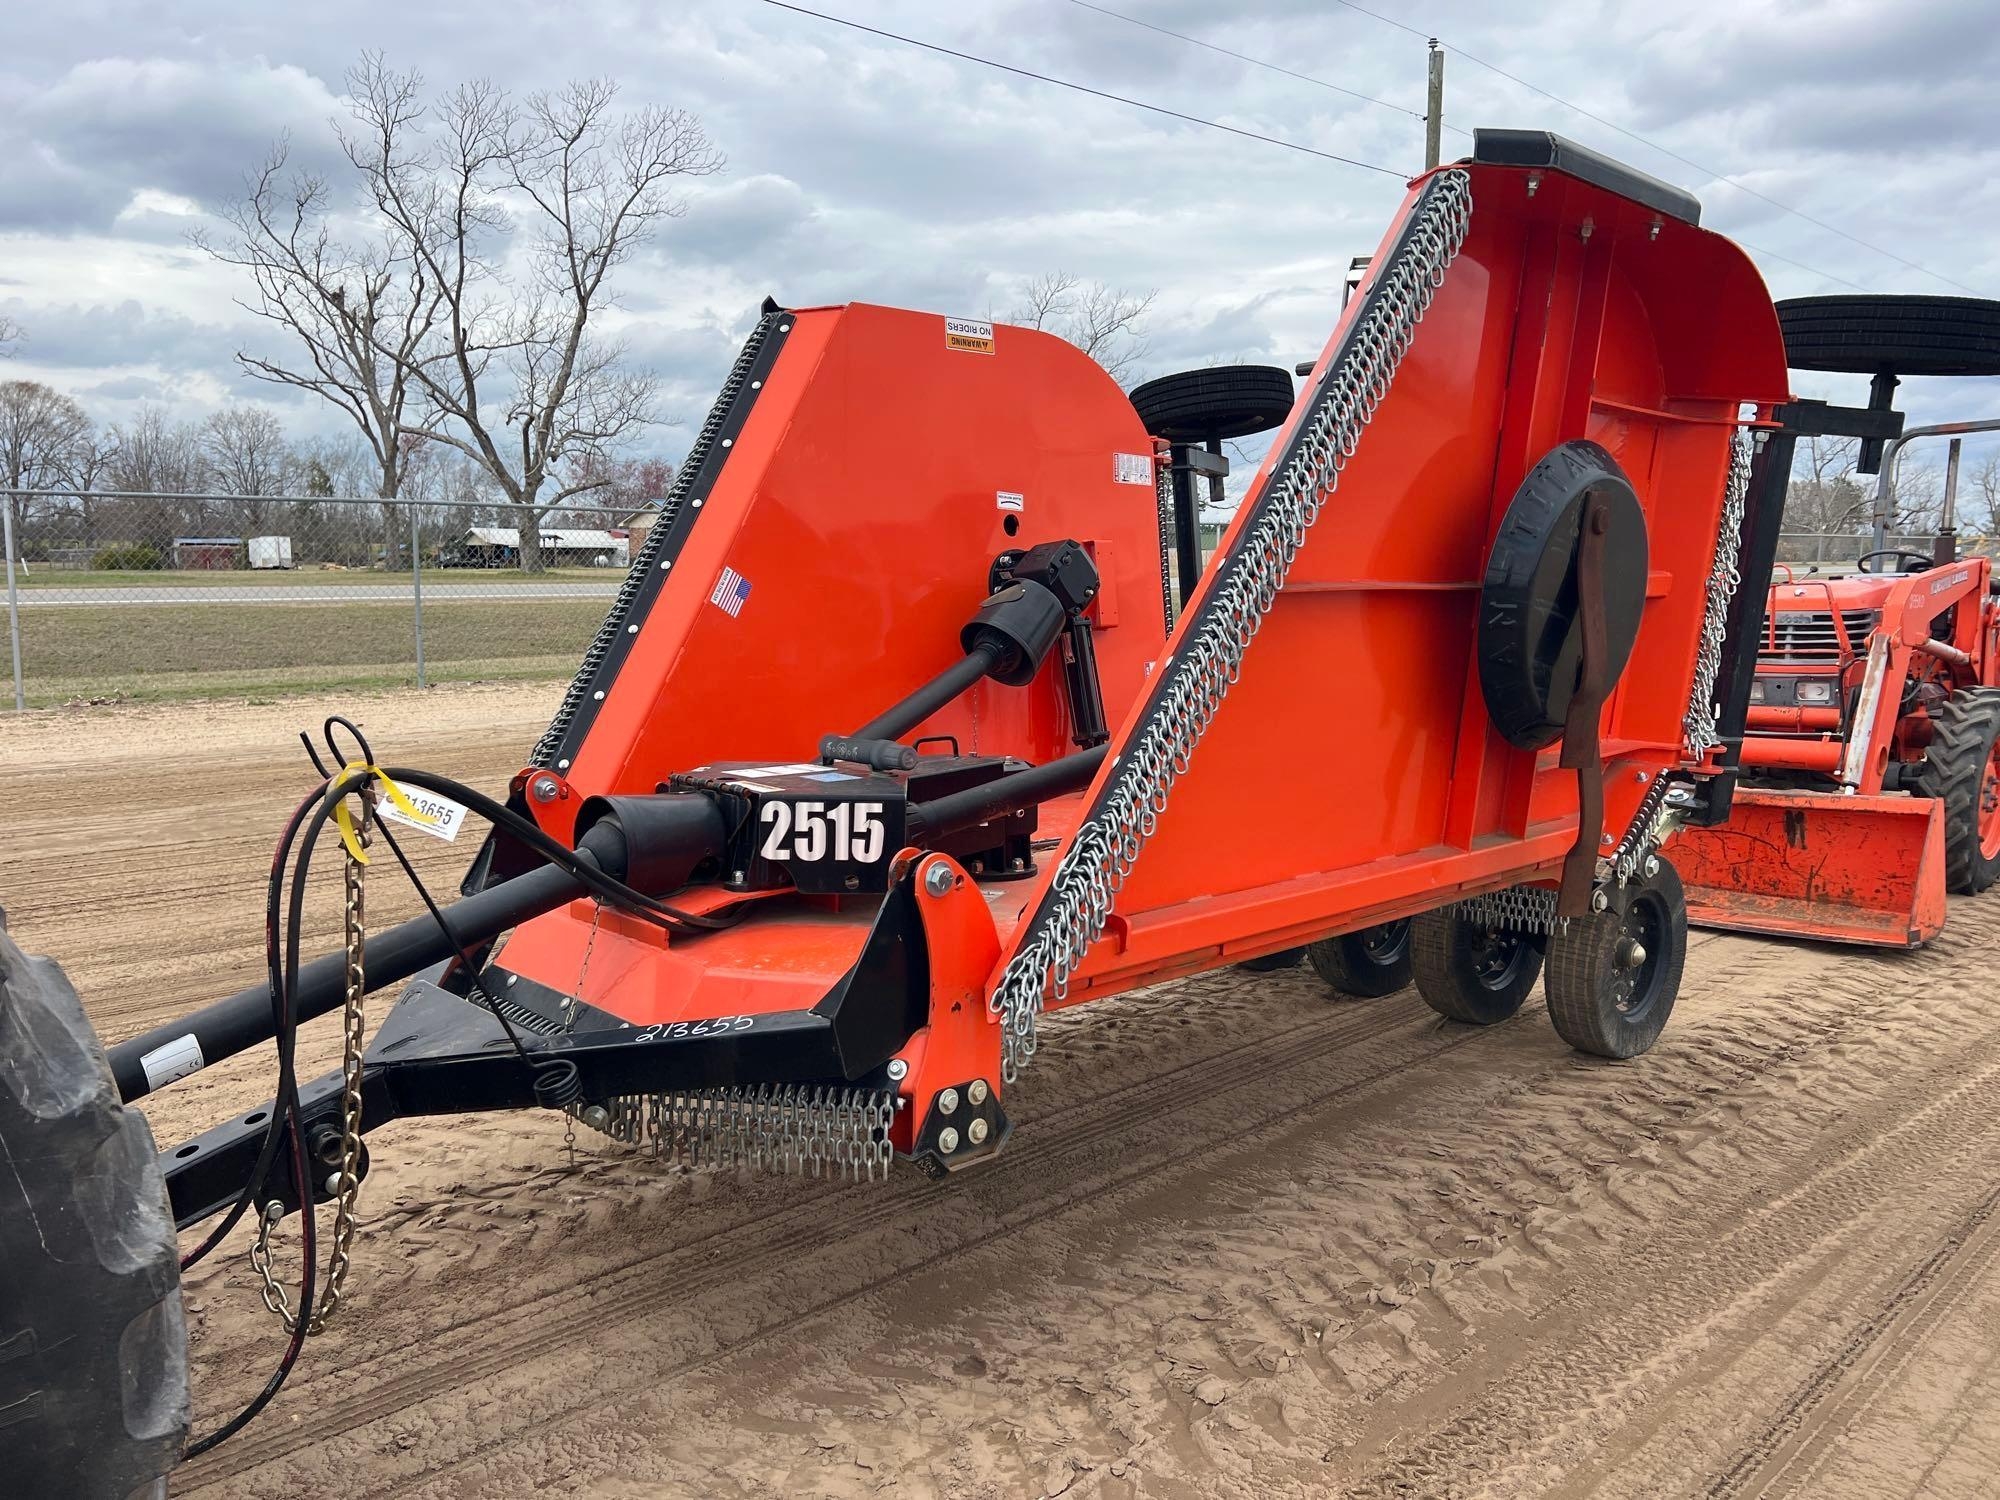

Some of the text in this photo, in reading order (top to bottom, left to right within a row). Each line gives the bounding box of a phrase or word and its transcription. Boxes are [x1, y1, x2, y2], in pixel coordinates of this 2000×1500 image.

[947, 322, 991, 336] NO RIDERS
[951, 337, 982, 348] WARNING
[760, 800, 885, 864] 2515
[635, 1013, 756, 1042] 213655
